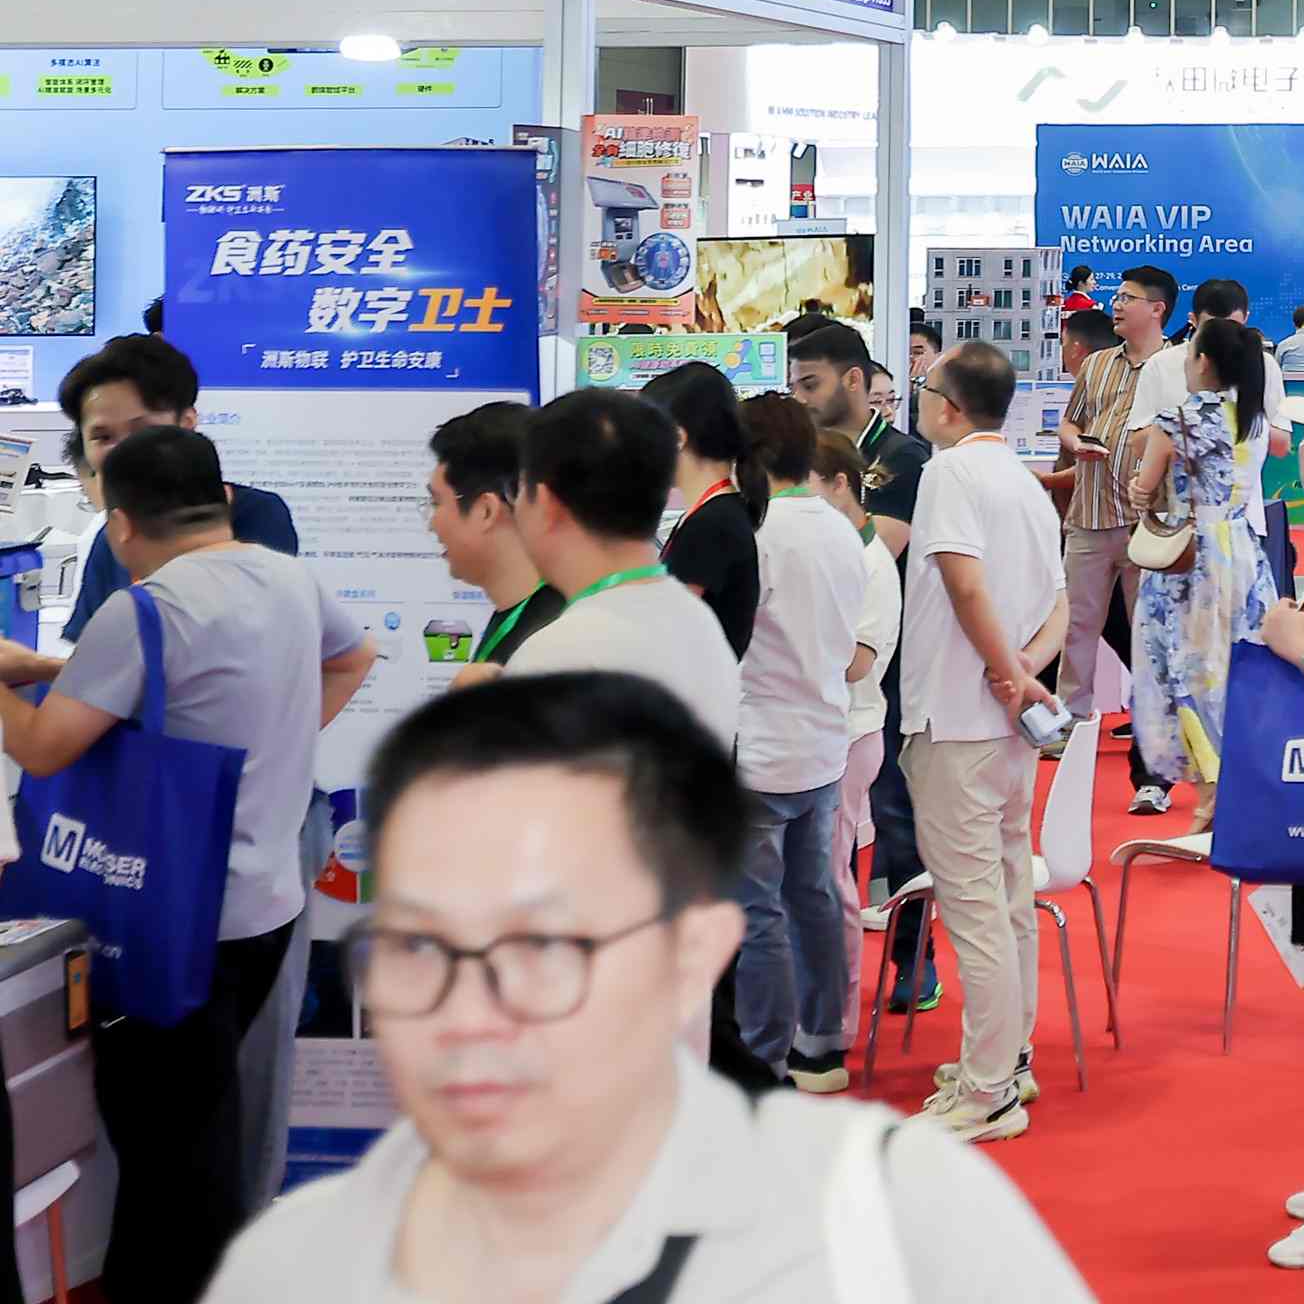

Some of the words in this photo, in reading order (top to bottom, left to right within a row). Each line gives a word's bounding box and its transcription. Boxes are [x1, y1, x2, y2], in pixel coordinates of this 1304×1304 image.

[1150, 65, 1300, 94] 田电子
[1092, 153, 1148, 169] WAIA
[185, 185, 243, 203] ZKS
[1061, 205, 1148, 230] WAIA
[1155, 205, 1212, 230] VIP
[210, 229, 414, 276] 食药安全
[1060, 235, 1193, 257] Networking
[1199, 236, 1253, 253] Area
[304, 287, 512, 333] 数字卫士
